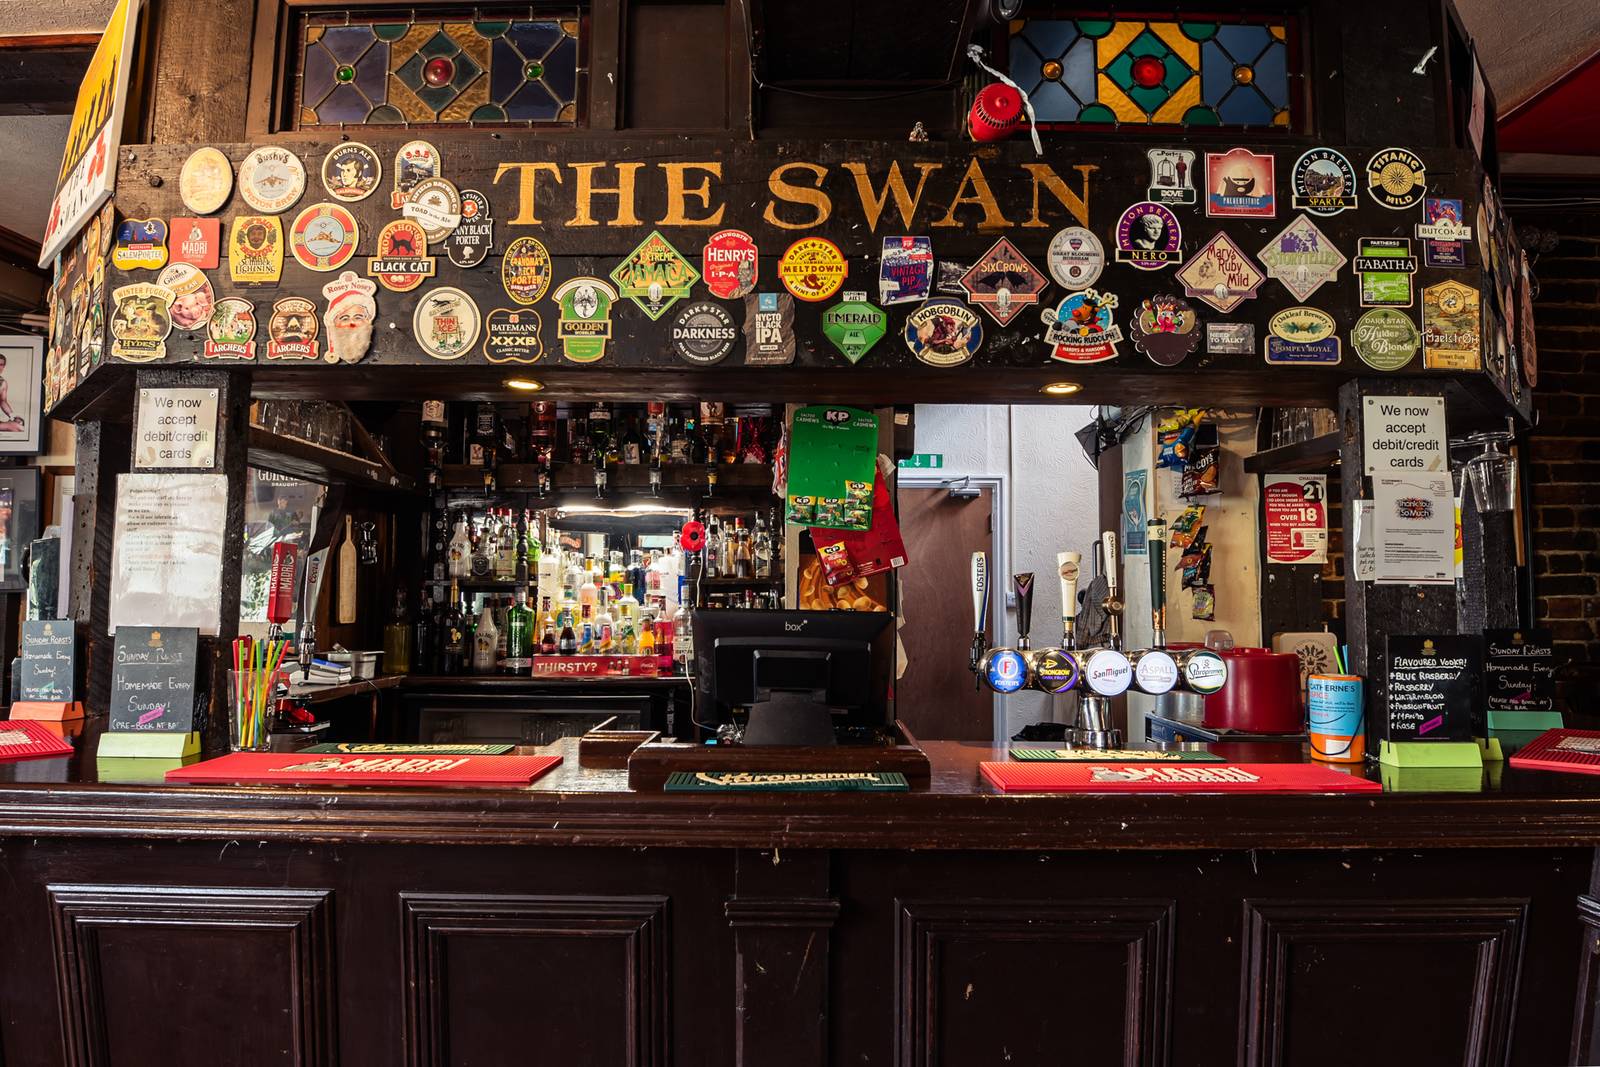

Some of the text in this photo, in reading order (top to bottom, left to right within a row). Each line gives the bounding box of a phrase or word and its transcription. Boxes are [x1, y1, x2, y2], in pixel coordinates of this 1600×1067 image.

[333, 147, 372, 162] BURNS ALE
[1373, 152, 1420, 170] TITANIC
[1297, 152, 1353, 193] MILTON BREWERY
[493, 156, 1100, 233] THE SWAN
[1385, 195, 1413, 205] MILD
[1308, 197, 1345, 206] SPARTA
[470, 224, 490, 235] BLACK
[1123, 207, 1144, 247] MILTON
[1149, 205, 1180, 249] BREWERY
[456, 236, 480, 245] PORTER
[640, 249, 674, 263] EXTREME
[708, 247, 755, 262] HENRY'S
[789, 243, 838, 261] DARK STAR
[1131, 251, 1168, 261] NERO
[373, 262, 430, 272] BLACK CAT
[783, 265, 843, 273] MELTDOWN
[891, 264, 926, 276] VINTAGE
[1218, 258, 1243, 275] Ruby
[1357, 259, 1414, 270] TABATHA
[511, 275, 544, 285] PORTER
[623, 262, 688, 288] JAMAICA
[901, 276, 916, 285] PIP
[1227, 274, 1249, 289] Mild
[117, 287, 171, 299] WINTER FUGGLE
[326, 282, 373, 294] Rosey Nosey
[793, 285, 809, 297] HINT
[822, 280, 838, 294] SPICE
[679, 306, 701, 325] DARK
[709, 306, 730, 325] STAR
[755, 313, 782, 321] NYCTO
[827, 313, 882, 324] EMERALD
[917, 306, 972, 322] HOBGOBLIN
[1277, 310, 1329, 325] Oakleaf Brewery
[435, 317, 455, 325] THIN
[564, 322, 604, 331] GOLDEN
[755, 320, 782, 329] BLACK
[1386, 317, 1406, 325] STAR
[491, 323, 537, 331] BATEMANS
[673, 328, 736, 339] DARKNESS
[755, 328, 783, 344] IPA
[1053, 332, 1115, 343] ROCKING RUDOLPH
[490, 336, 536, 346] XXXB
[1371, 338, 1413, 354] Blonde
[213, 343, 247, 353] ARCHERS
[277, 343, 311, 353] ARCHERS
[709, 351, 723, 361] BLACK
[154, 397, 202, 408] We now
[826, 410, 849, 421] KP
[1380, 405, 1430, 416] We now
[157, 414, 197, 427] accept
[1385, 423, 1426, 435] accept
[144, 430, 208, 443] debit/credit
[1372, 439, 1440, 451] debit/credit
[159, 448, 192, 459] cards
[1390, 456, 1424, 467] cards
[1303, 483, 1323, 500] 21
[1299, 507, 1318, 522] 18
[1410, 508, 1430, 516] Much
[825, 546, 840, 554] KP
[785, 621, 802, 631] box
[25, 634, 72, 645] SUNDAY ROASTS
[117, 645, 150, 663] SUNDAY
[1489, 642, 1520, 656] SUNDAY
[1394, 656, 1437, 666] FLAVOURED
[536, 662, 598, 672] THIRSTY?
[1002, 660, 1011, 674] F
[1040, 668, 1071, 677] STRONGBOW
[1139, 664, 1175, 674] ASPALL
[1188, 662, 1224, 681] Staropramen
[1486, 662, 1529, 672] Homemade
[117, 674, 163, 691] HOMEMADE
[1394, 692, 1444, 701] WATERMELON
[696, 771, 880, 785] Staropramen
